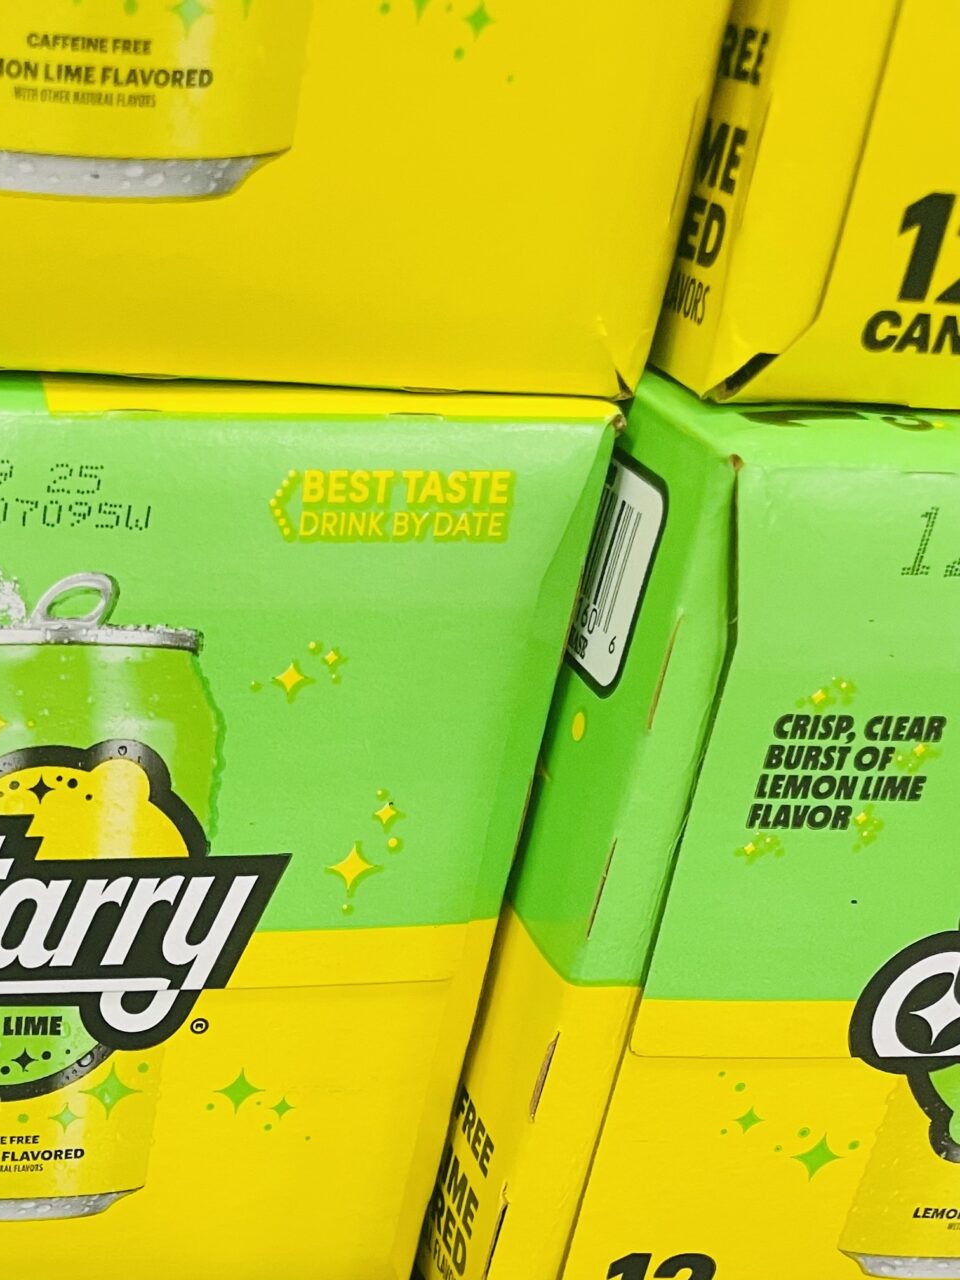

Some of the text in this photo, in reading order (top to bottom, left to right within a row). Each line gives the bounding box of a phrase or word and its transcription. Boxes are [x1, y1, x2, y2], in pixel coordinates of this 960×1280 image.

[26, 33, 152, 55] CAFFEINE FREE
[44, 63, 96, 85] LIME
[101, 66, 214, 89] FLAVORED
[47, 464, 104, 494] 25
[301, 470, 511, 504] BEST TASTE
[299, 511, 505, 536] DRINK BY DATE
[773, 714, 947, 744] CRISP, CLEAR
[763, 744, 895, 771] BURST OF
[754, 774, 927, 801] LEMON LIME
[746, 804, 852, 830] FLAVOR
[3, 1016, 63, 1036] LIME
[10, 1135, 40, 1144] FREE
[1, 1149, 85, 1161] FLAVORED
[14, 1164, 44, 1173] FLAVORS
[912, 1207, 960, 1219] LEMO
